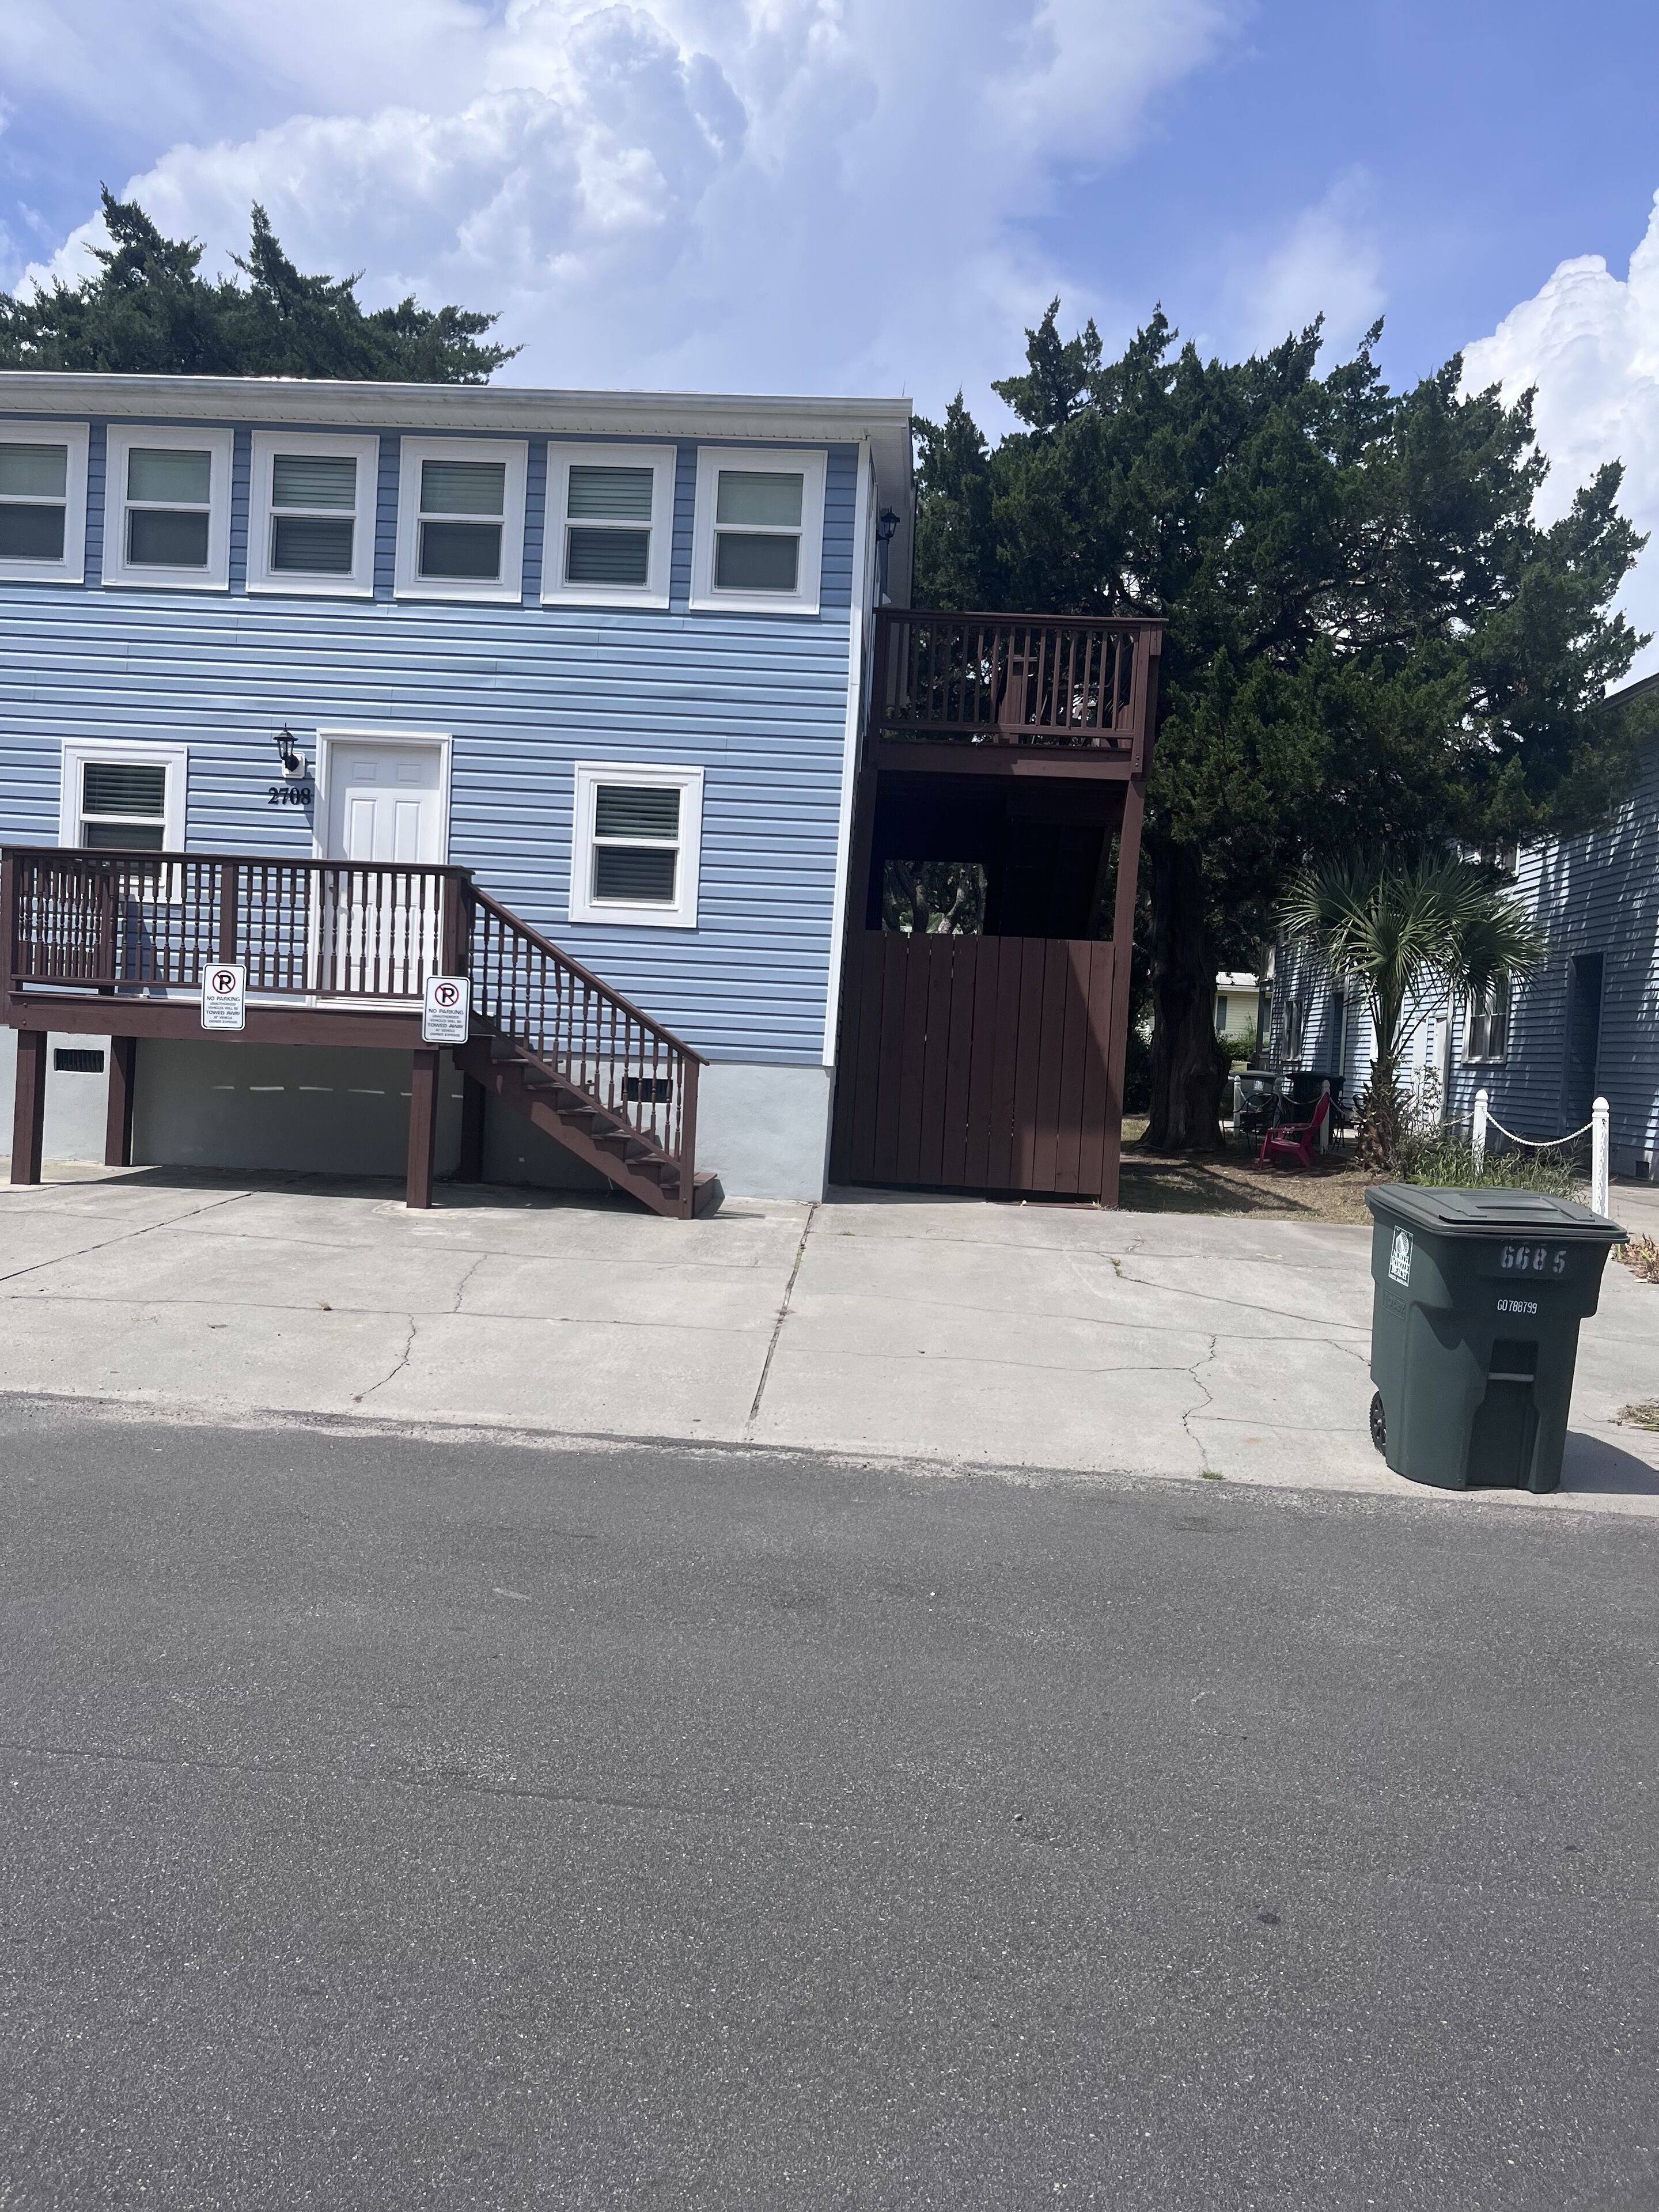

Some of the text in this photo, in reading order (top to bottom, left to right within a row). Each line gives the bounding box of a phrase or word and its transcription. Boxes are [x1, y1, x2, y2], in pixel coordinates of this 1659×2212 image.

[267, 787, 311, 805] 2708
[1393, 1249, 1409, 1264] NORTH
[1500, 1245, 1567, 1273] 6685
[1391, 1264, 1407, 1280] BEACH
